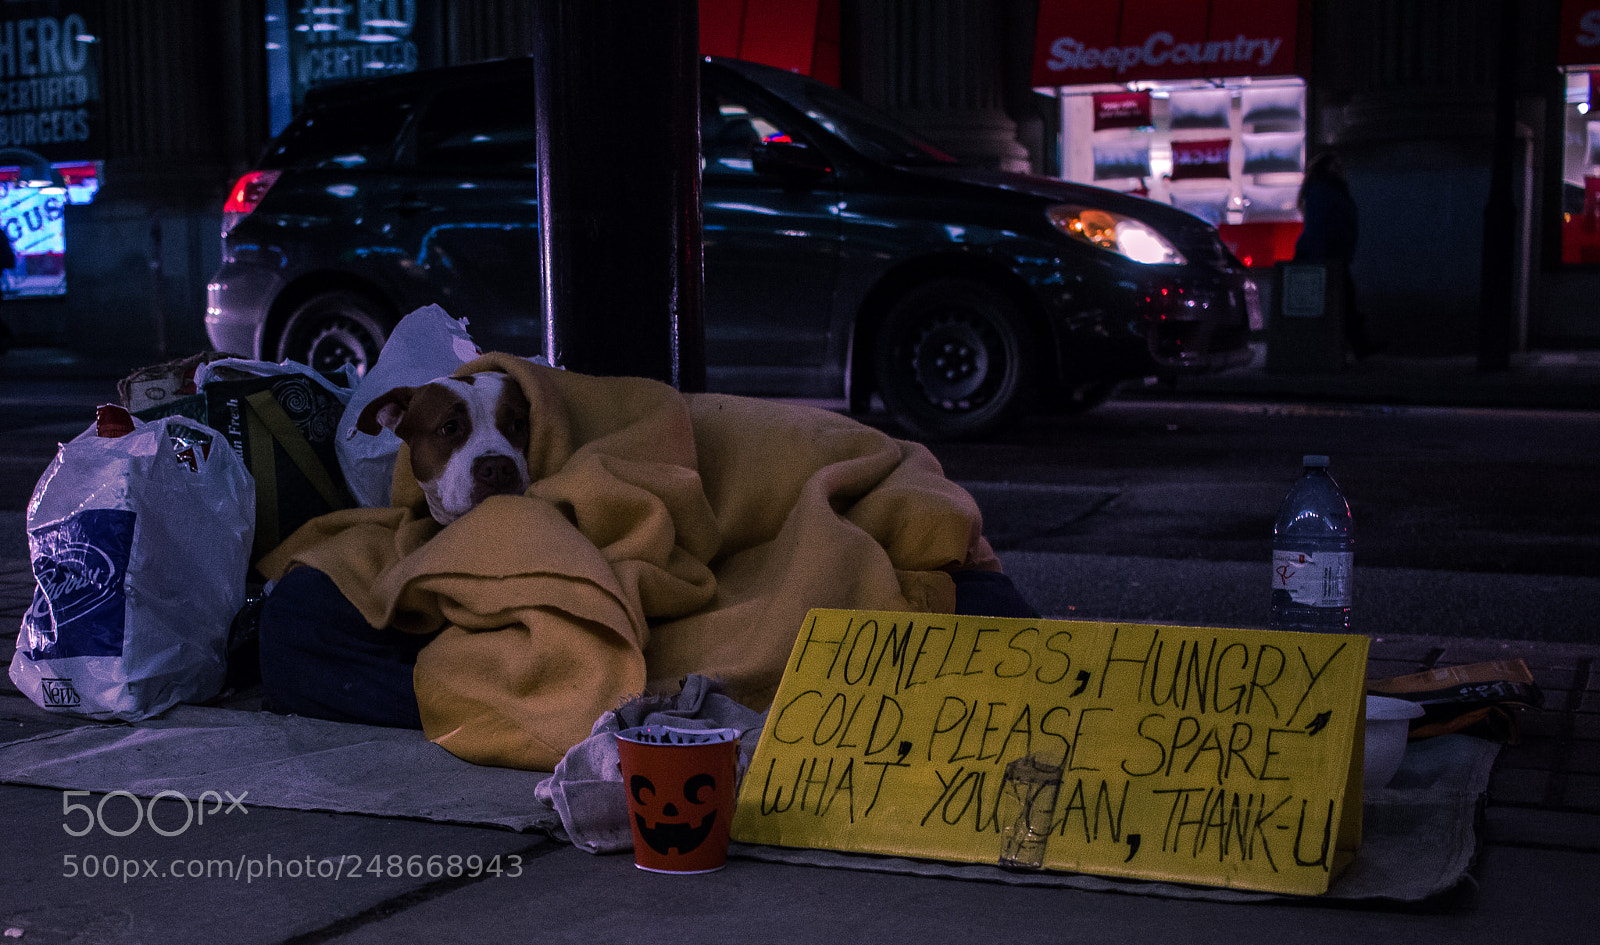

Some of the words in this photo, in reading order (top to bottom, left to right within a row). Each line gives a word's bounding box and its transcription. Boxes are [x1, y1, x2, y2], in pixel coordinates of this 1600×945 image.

[0, 12, 88, 77] HERO
[41, 681, 81, 705] News
[795, 616, 1090, 698] HOMELESS,
[927, 696, 1114, 774] PLEASE
[1121, 713, 1306, 785] SPARE
[761, 757, 911, 825] WHAT
[921, 766, 1009, 834] YOU
[1153, 786, 1334, 873] THANK-U
